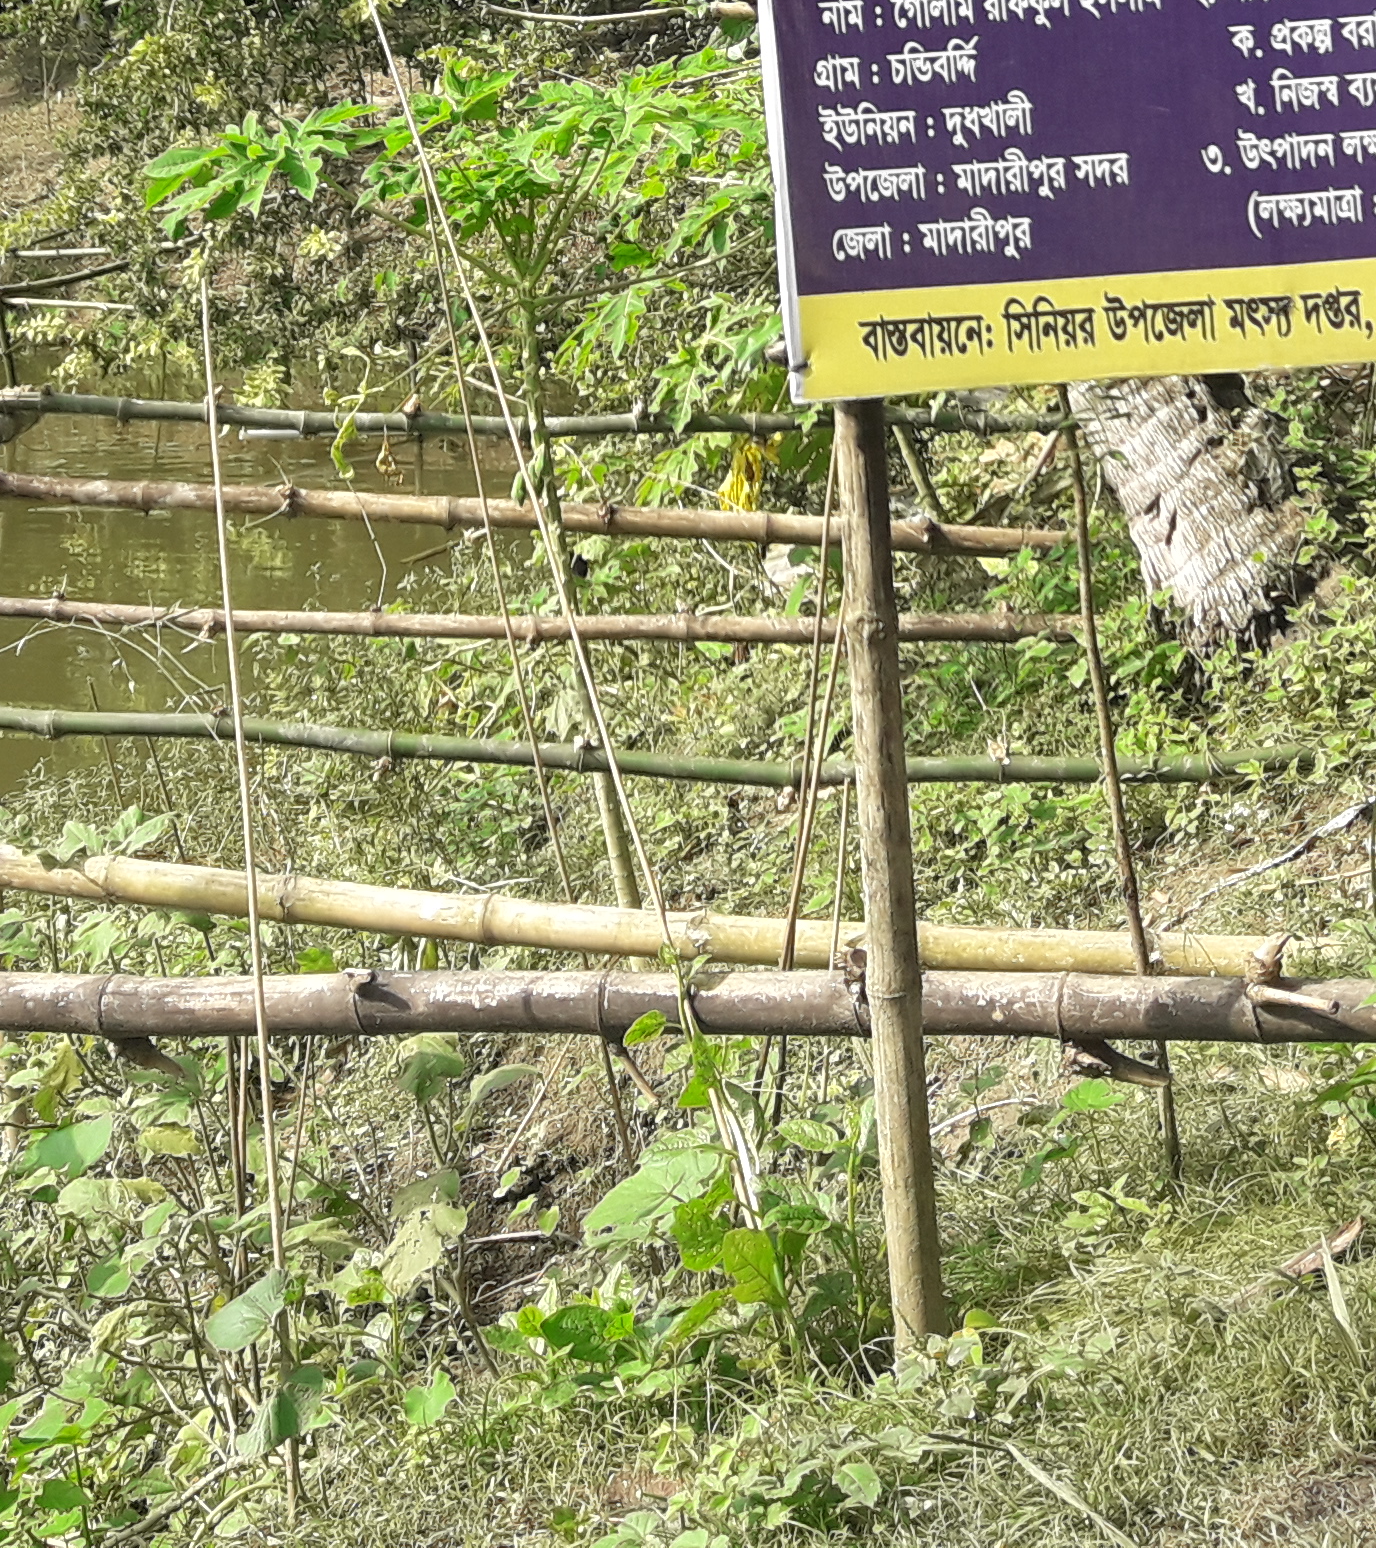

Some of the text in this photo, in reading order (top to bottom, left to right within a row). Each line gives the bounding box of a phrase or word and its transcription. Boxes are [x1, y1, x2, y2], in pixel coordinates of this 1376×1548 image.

[1269, 16, 1334, 56] প্রকল্প
[812, 52, 862, 93] গ্রাম
[1268, 66, 1342, 116] নিজস্ব
[817, 101, 918, 152] ইউনিয়ন
[940, 89, 1035, 149] দুধখালী
[1235, 126, 1337, 172] উৎপাদন
[823, 161, 928, 204] উপজেলা
[951, 147, 1067, 202] মাদারীপুর
[1070, 150, 1132, 188] সদর
[830, 220, 894, 263] জেলা
[917, 206, 1033, 260] মাদারীপুর
[1246, 182, 1365, 240] (লক্ষ্যমাত্রা
[1001, 295, 1096, 353] সিনিয়র
[1101, 290, 1217, 346] উপজেলা
[1222, 294, 1296, 340] মৎস্য
[1299, 283, 1375, 341] দপ্তর,
